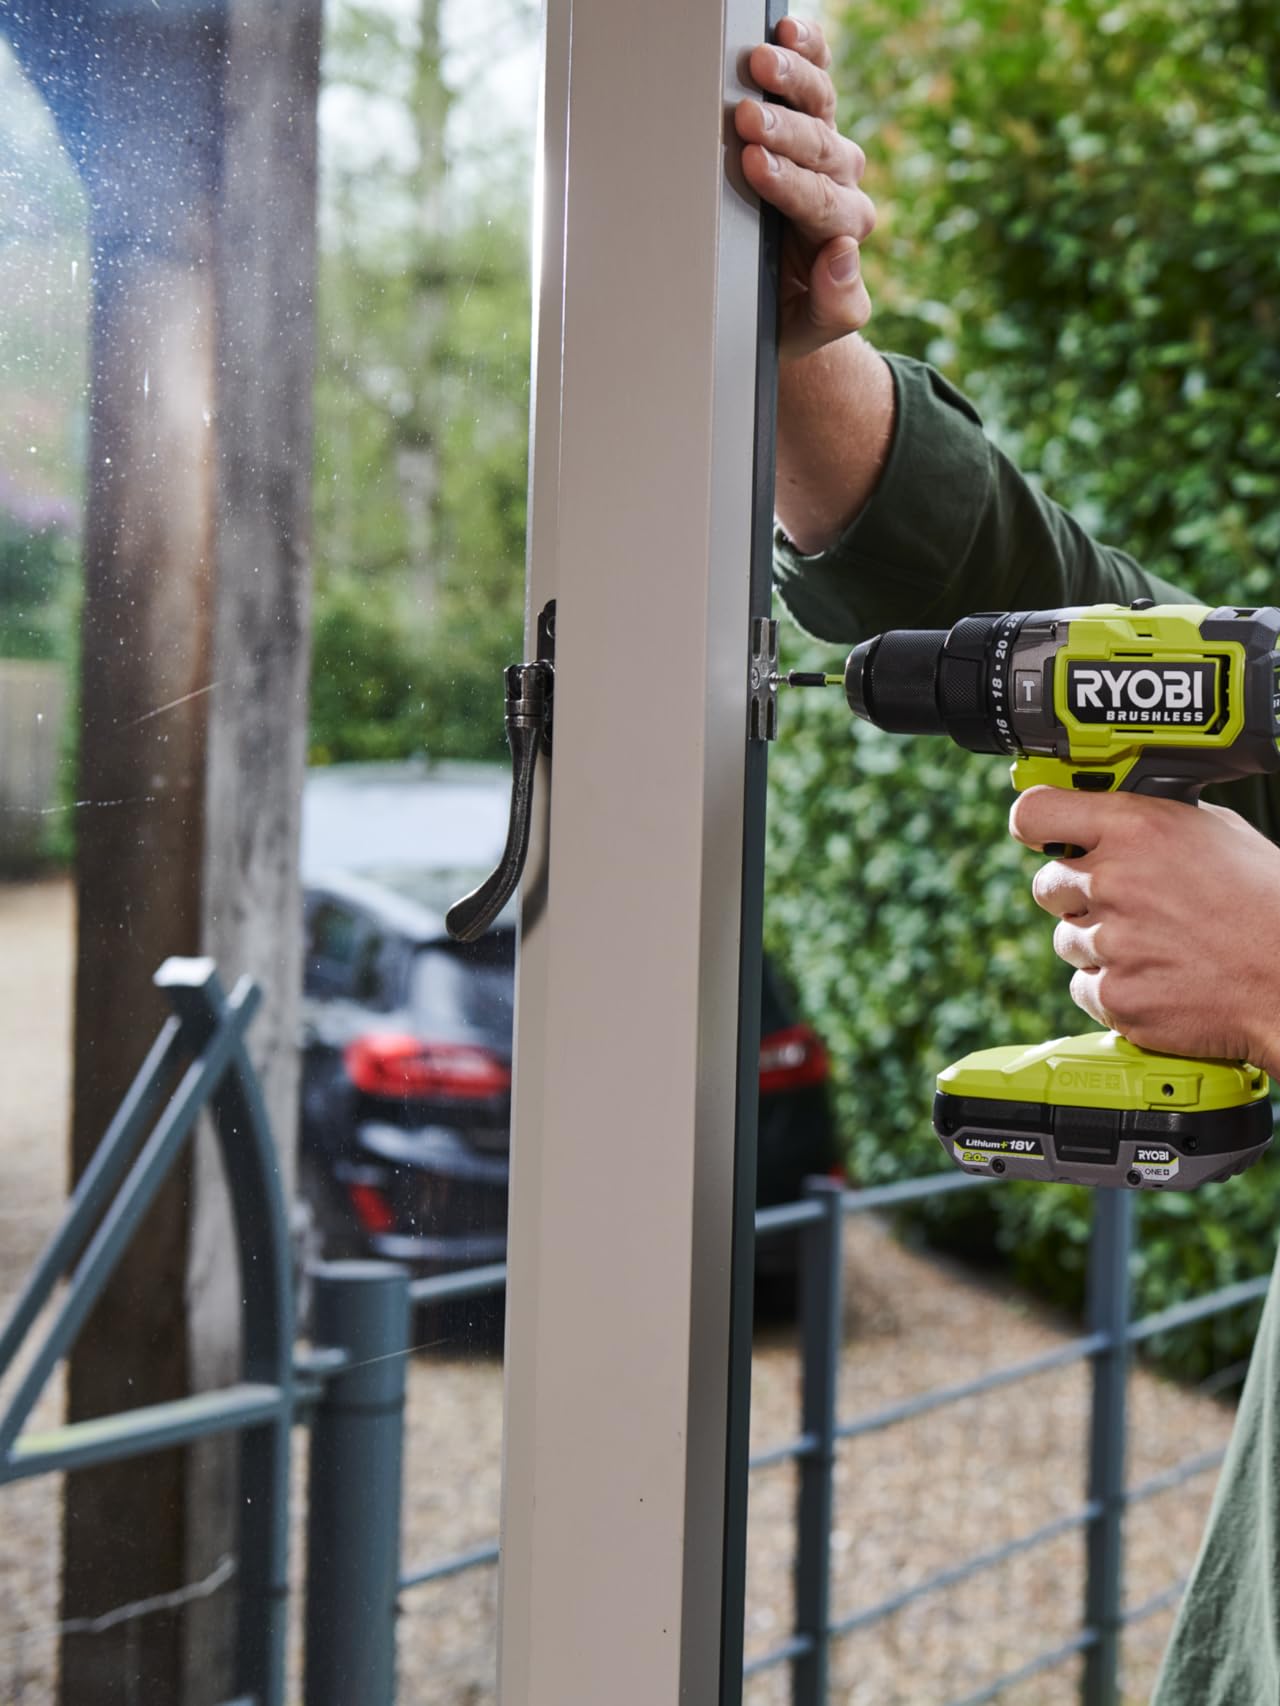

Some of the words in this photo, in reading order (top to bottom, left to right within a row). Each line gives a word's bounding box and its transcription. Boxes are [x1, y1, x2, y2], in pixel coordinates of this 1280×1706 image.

[995, 640, 1008, 660] 20
[992, 678, 1003, 698] 18
[1073, 669, 1203, 709] RYOBI
[1106, 710, 1203, 722] BRUSHLESS
[996, 718, 1011, 736] 16
[1010, 1140, 1036, 1152] 18V
[1137, 1149, 1169, 1161] RYOBI
